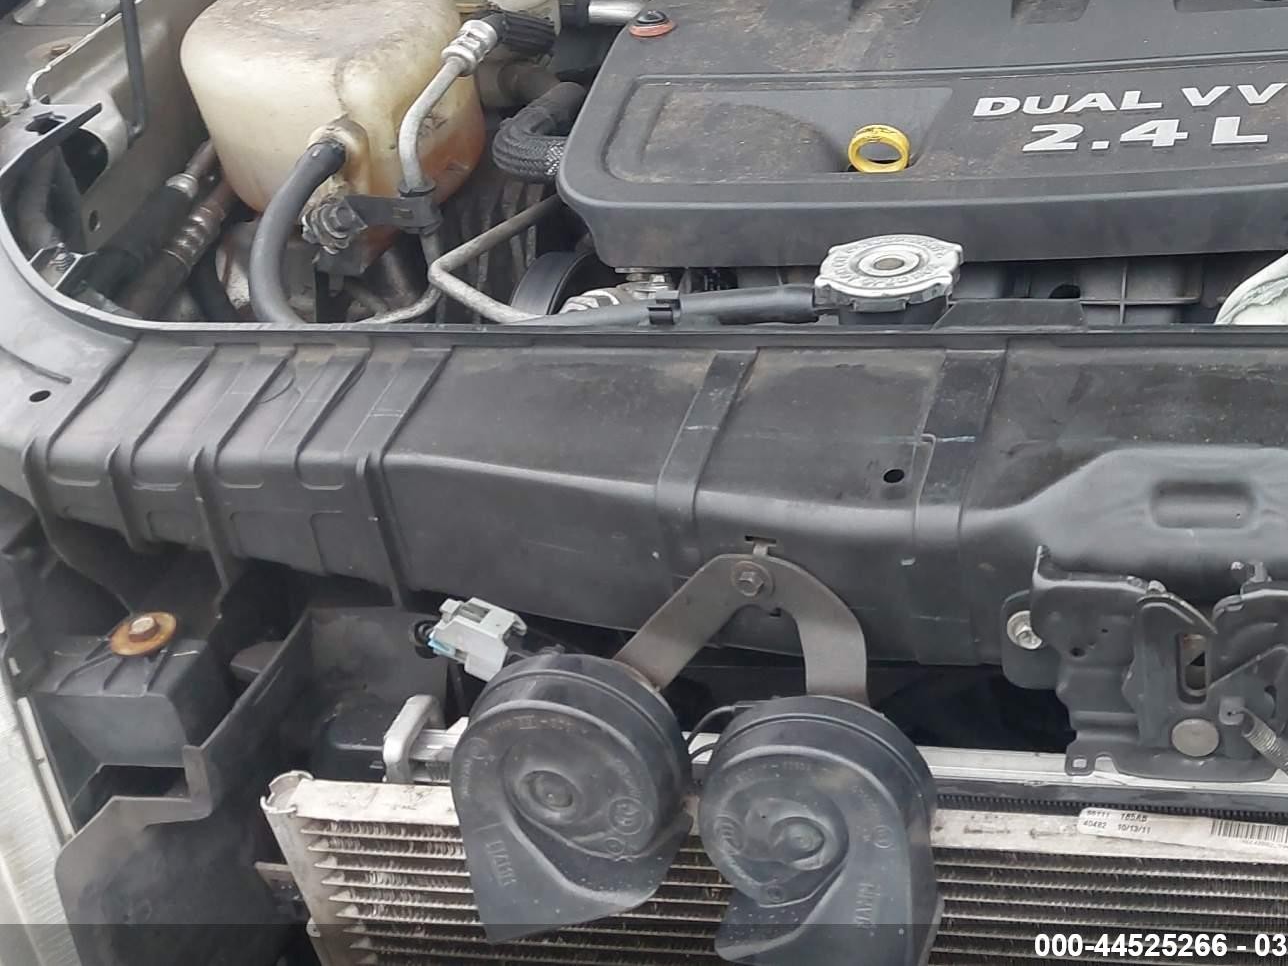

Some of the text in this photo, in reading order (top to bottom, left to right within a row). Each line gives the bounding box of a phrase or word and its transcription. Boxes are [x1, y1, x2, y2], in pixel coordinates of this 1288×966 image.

[973, 90, 1163, 117] DUAL
[1022, 116, 1268, 153] 2.4 L
